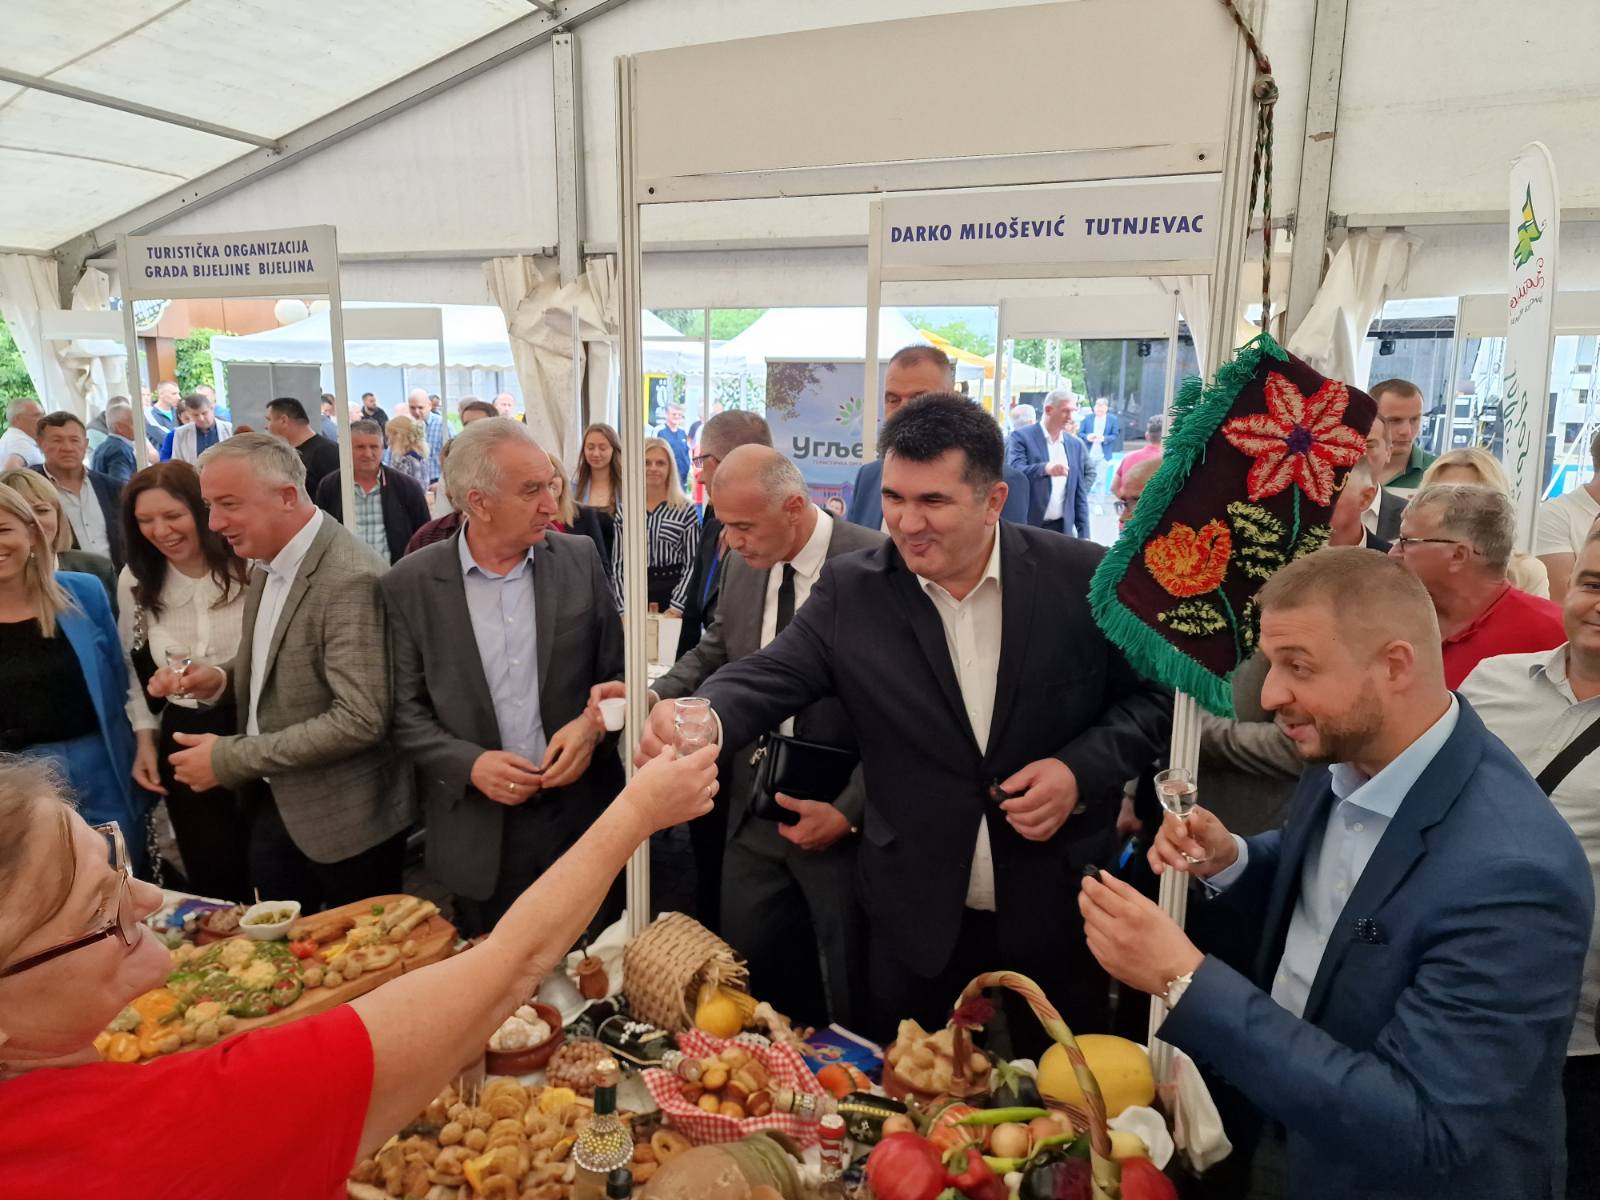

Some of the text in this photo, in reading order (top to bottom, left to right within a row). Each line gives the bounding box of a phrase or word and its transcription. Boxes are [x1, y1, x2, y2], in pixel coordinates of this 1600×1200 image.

[892, 214, 1204, 243] DARKO MILOŠEVIĆ TUTNJEVAC
[147, 240, 310, 260] TURISTIČKA ORGANIZACIJA
[145, 259, 315, 278] GRADA BIJELJINE BIJELJINA
[792, 436, 865, 459] Угље
